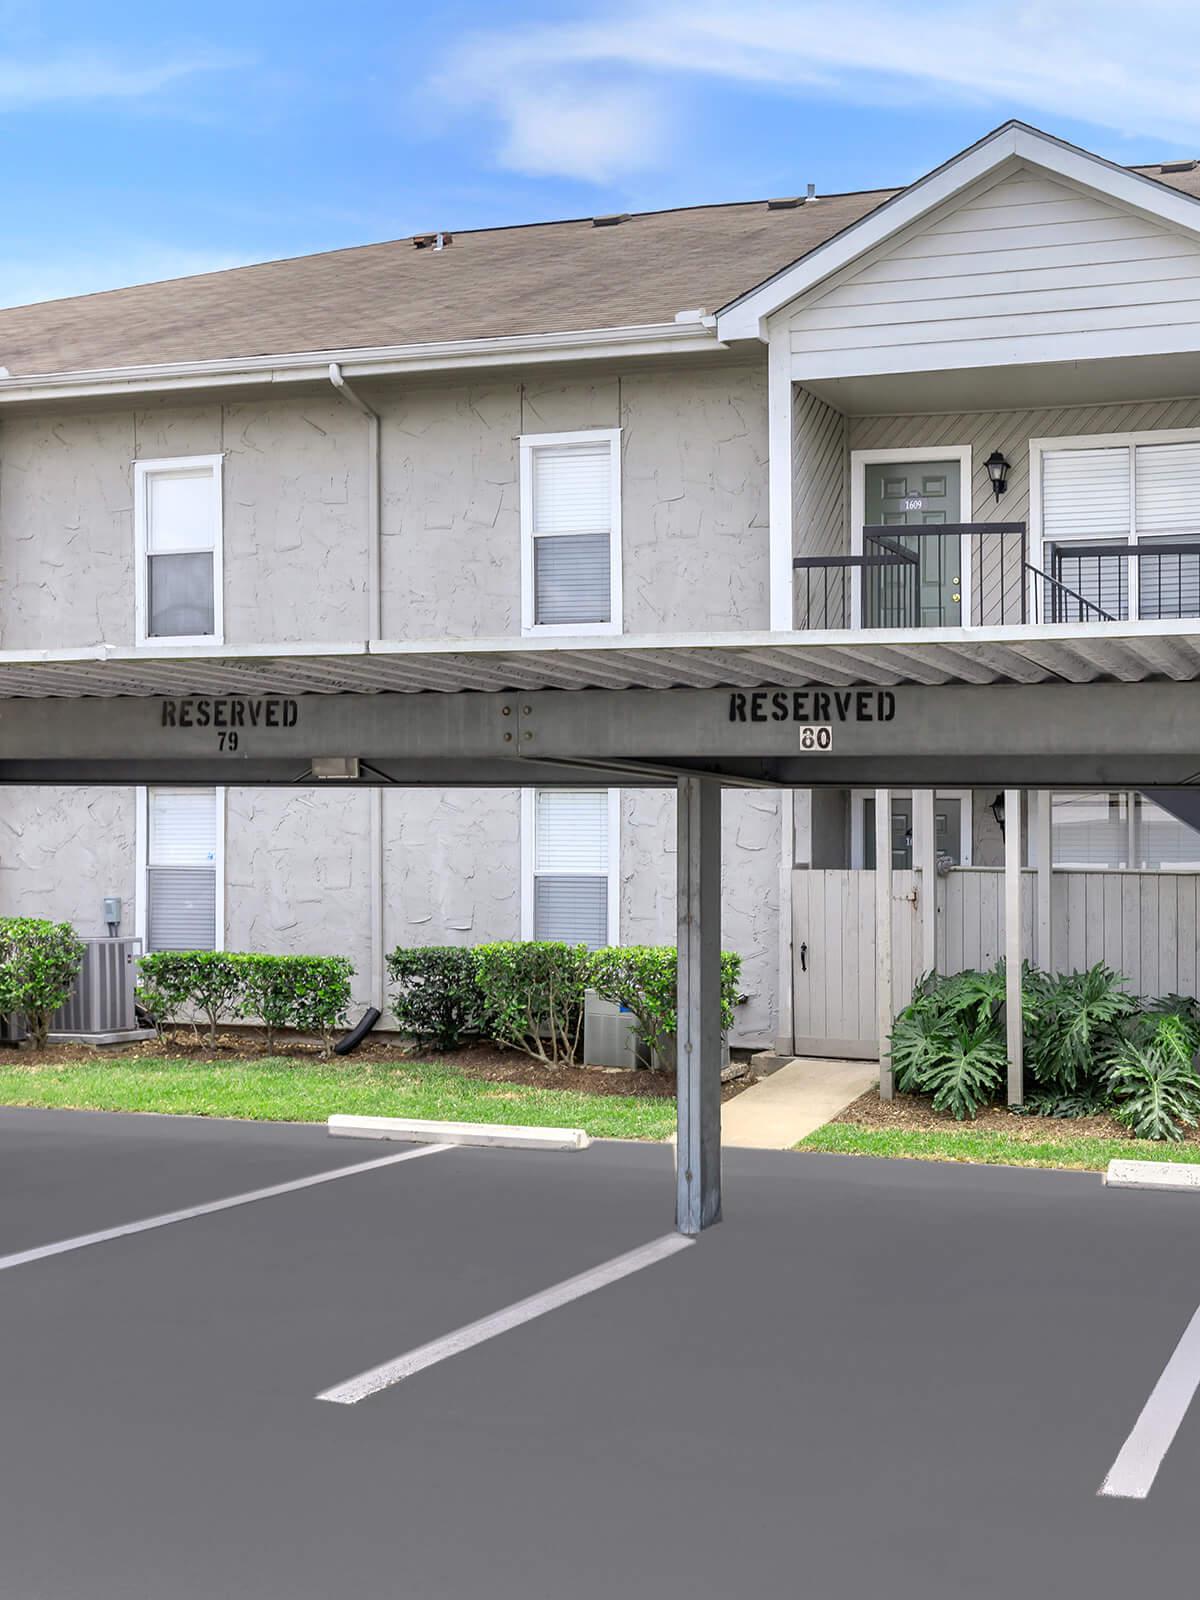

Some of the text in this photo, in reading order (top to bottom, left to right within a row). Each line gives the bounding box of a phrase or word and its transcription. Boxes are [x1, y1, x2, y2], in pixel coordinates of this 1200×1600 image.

[905, 500, 922, 510] 1609
[161, 699, 298, 727] RESERVED
[729, 691, 896, 722] RESERVED
[217, 731, 239, 752] 79
[801, 727, 831, 749] 80
